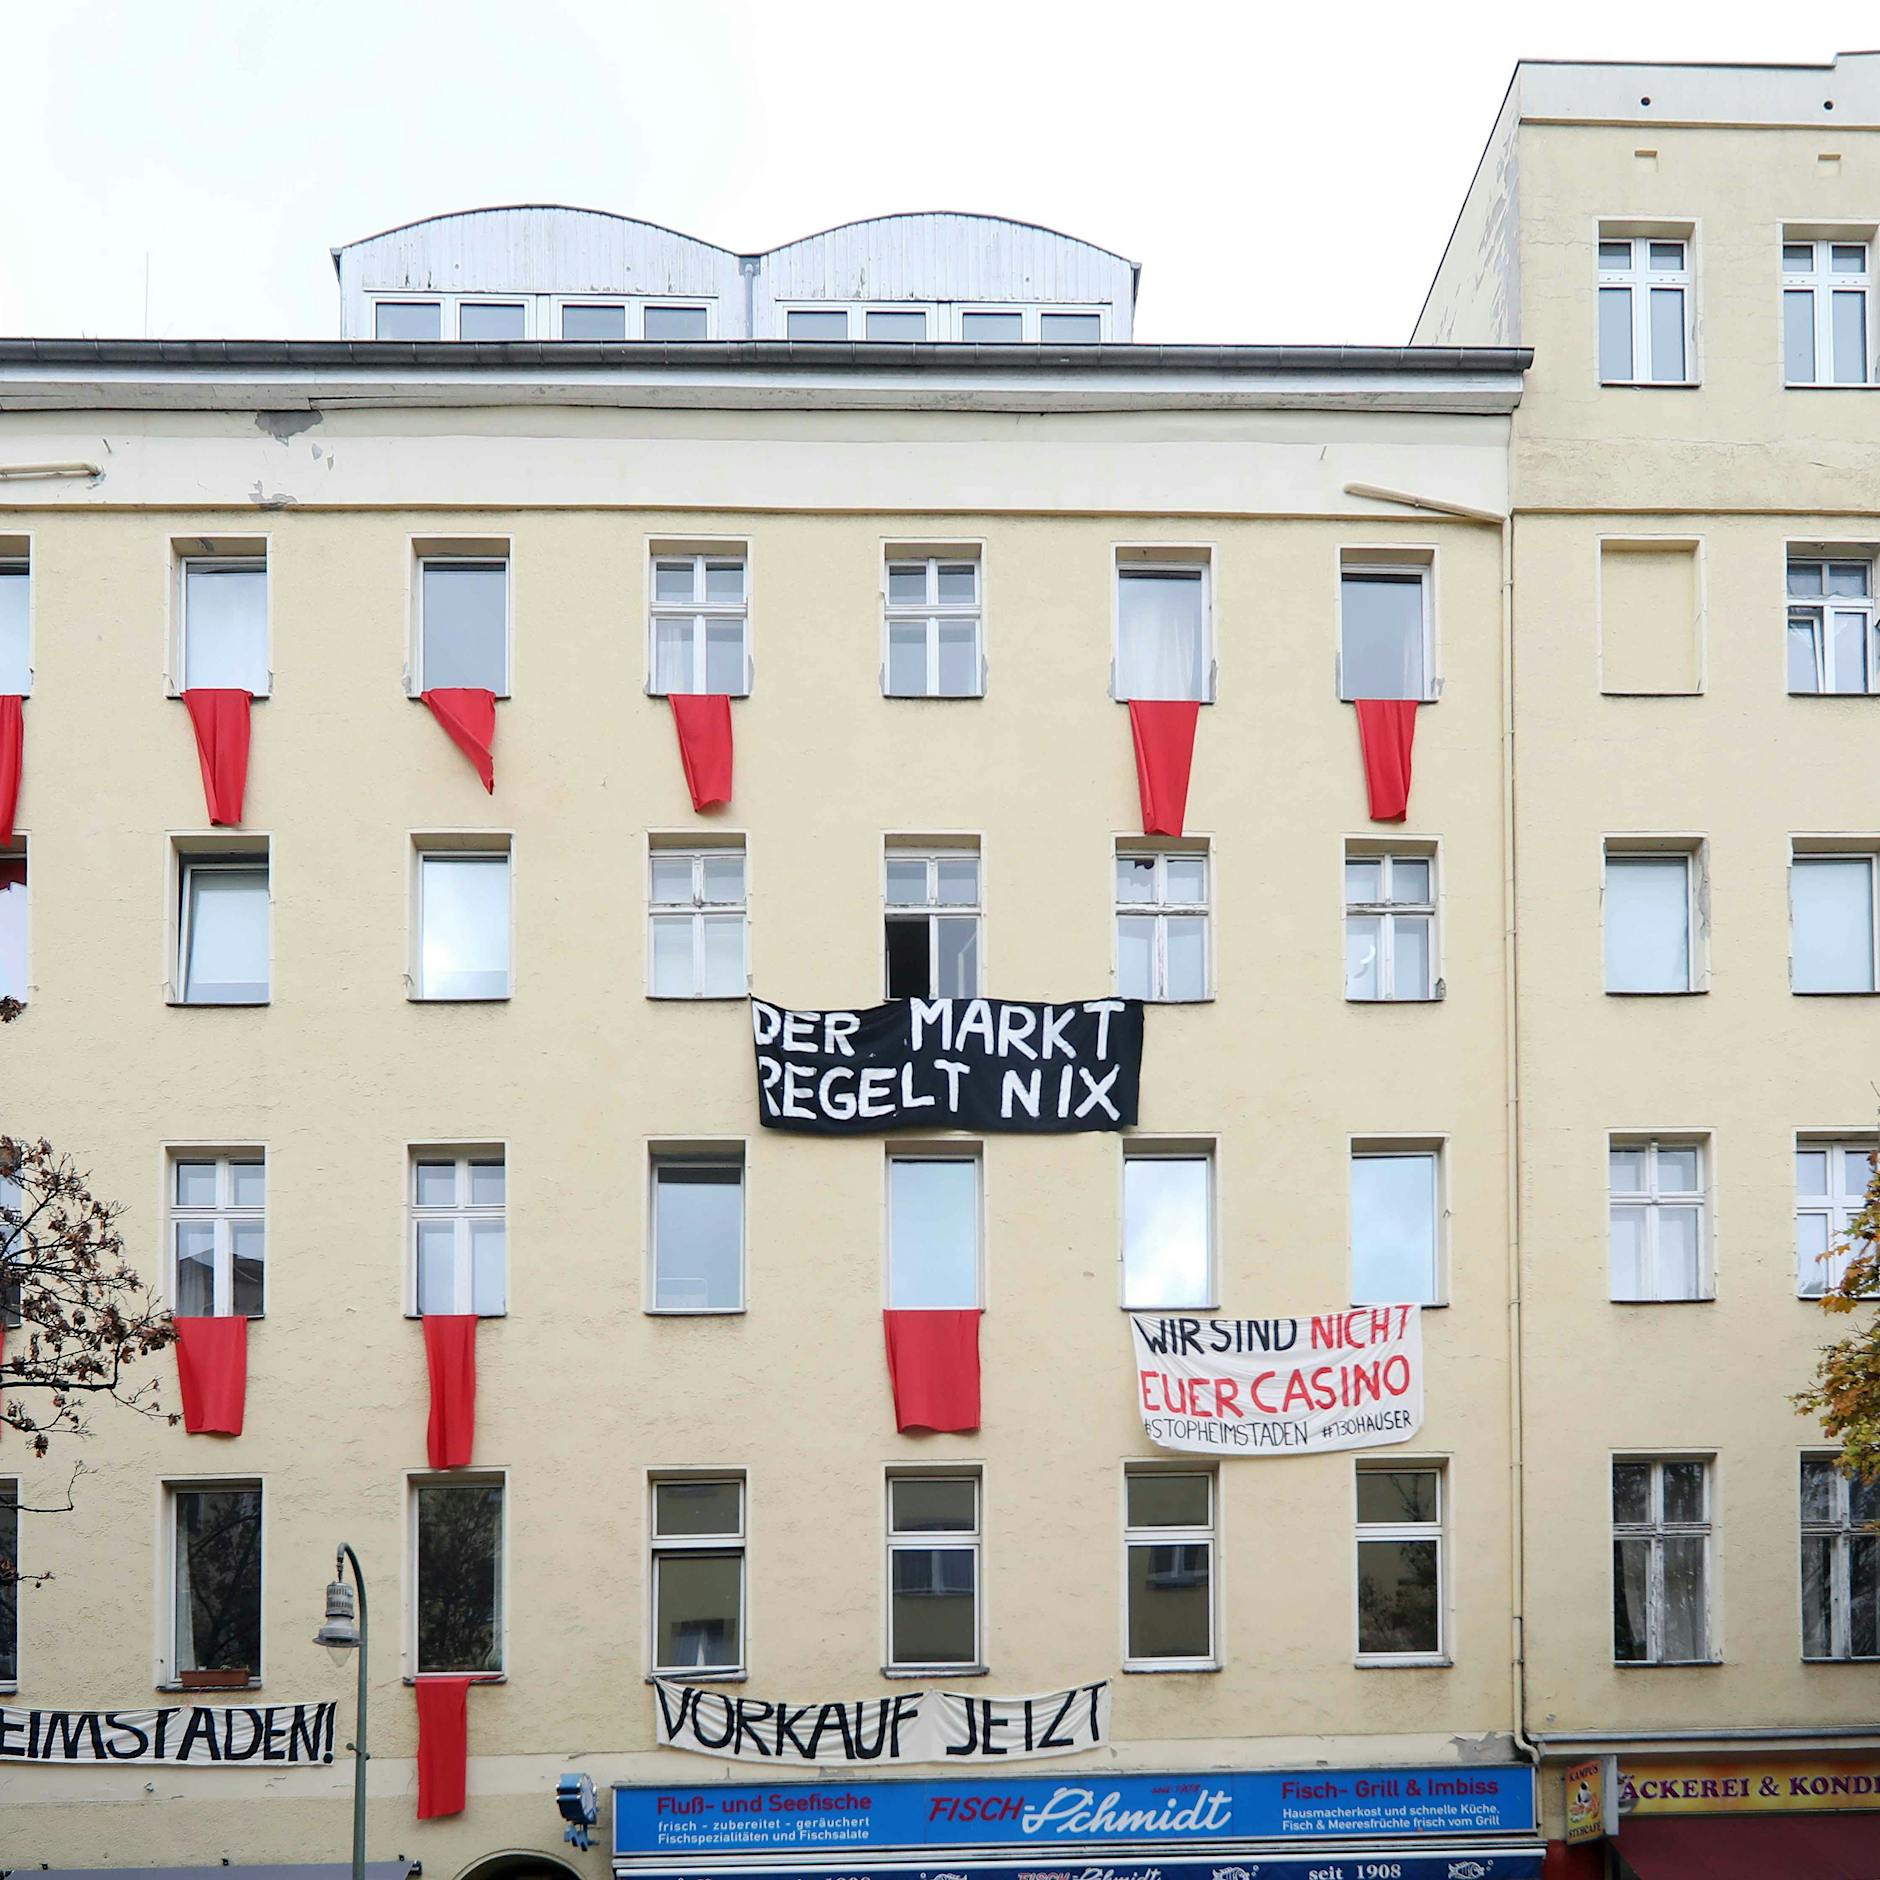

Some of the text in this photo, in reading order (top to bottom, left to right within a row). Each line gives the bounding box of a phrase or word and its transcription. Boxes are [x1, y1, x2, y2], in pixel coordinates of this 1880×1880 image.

[752, 997, 1125, 1060] DER MARKT
[758, 1055, 1120, 1121] REGELT NIX
[1132, 1304, 1413, 1356] WIR SIND NICHT
[1140, 1355, 1410, 1418] EUER CASINO
[1144, 1418, 1308, 1447] #STOPHEIMSTADEN
[655, 1679, 923, 1759] VORKAUF
[0, 1702, 337, 1763] EIMSTADEN!
[1282, 1777, 1499, 1799] Fisch- Grill & Imbiss
[1618, 1774, 1750, 1799] ÄCKEREI
[1758, 1776, 1780, 1797] &
[657, 1792, 872, 1815] Fluß- und Seefische
[1282, 1806, 1381, 1819] Hausmacherkost
[1384, 1805, 1406, 1816] und
[1409, 1803, 1457, 1815] schnelle
[658, 1820, 697, 1832] frisch
[713, 1818, 780, 1831] zubereitet
[796, 1817, 870, 1831] geräuchert
[1282, 1815, 1500, 1831] Fisch & Meeresfrüchte frisch vom Grill
[658, 1829, 869, 1845] Fischspezialitäten und Fischsalate
[1309, 1863, 1401, 1880] seit 1908
